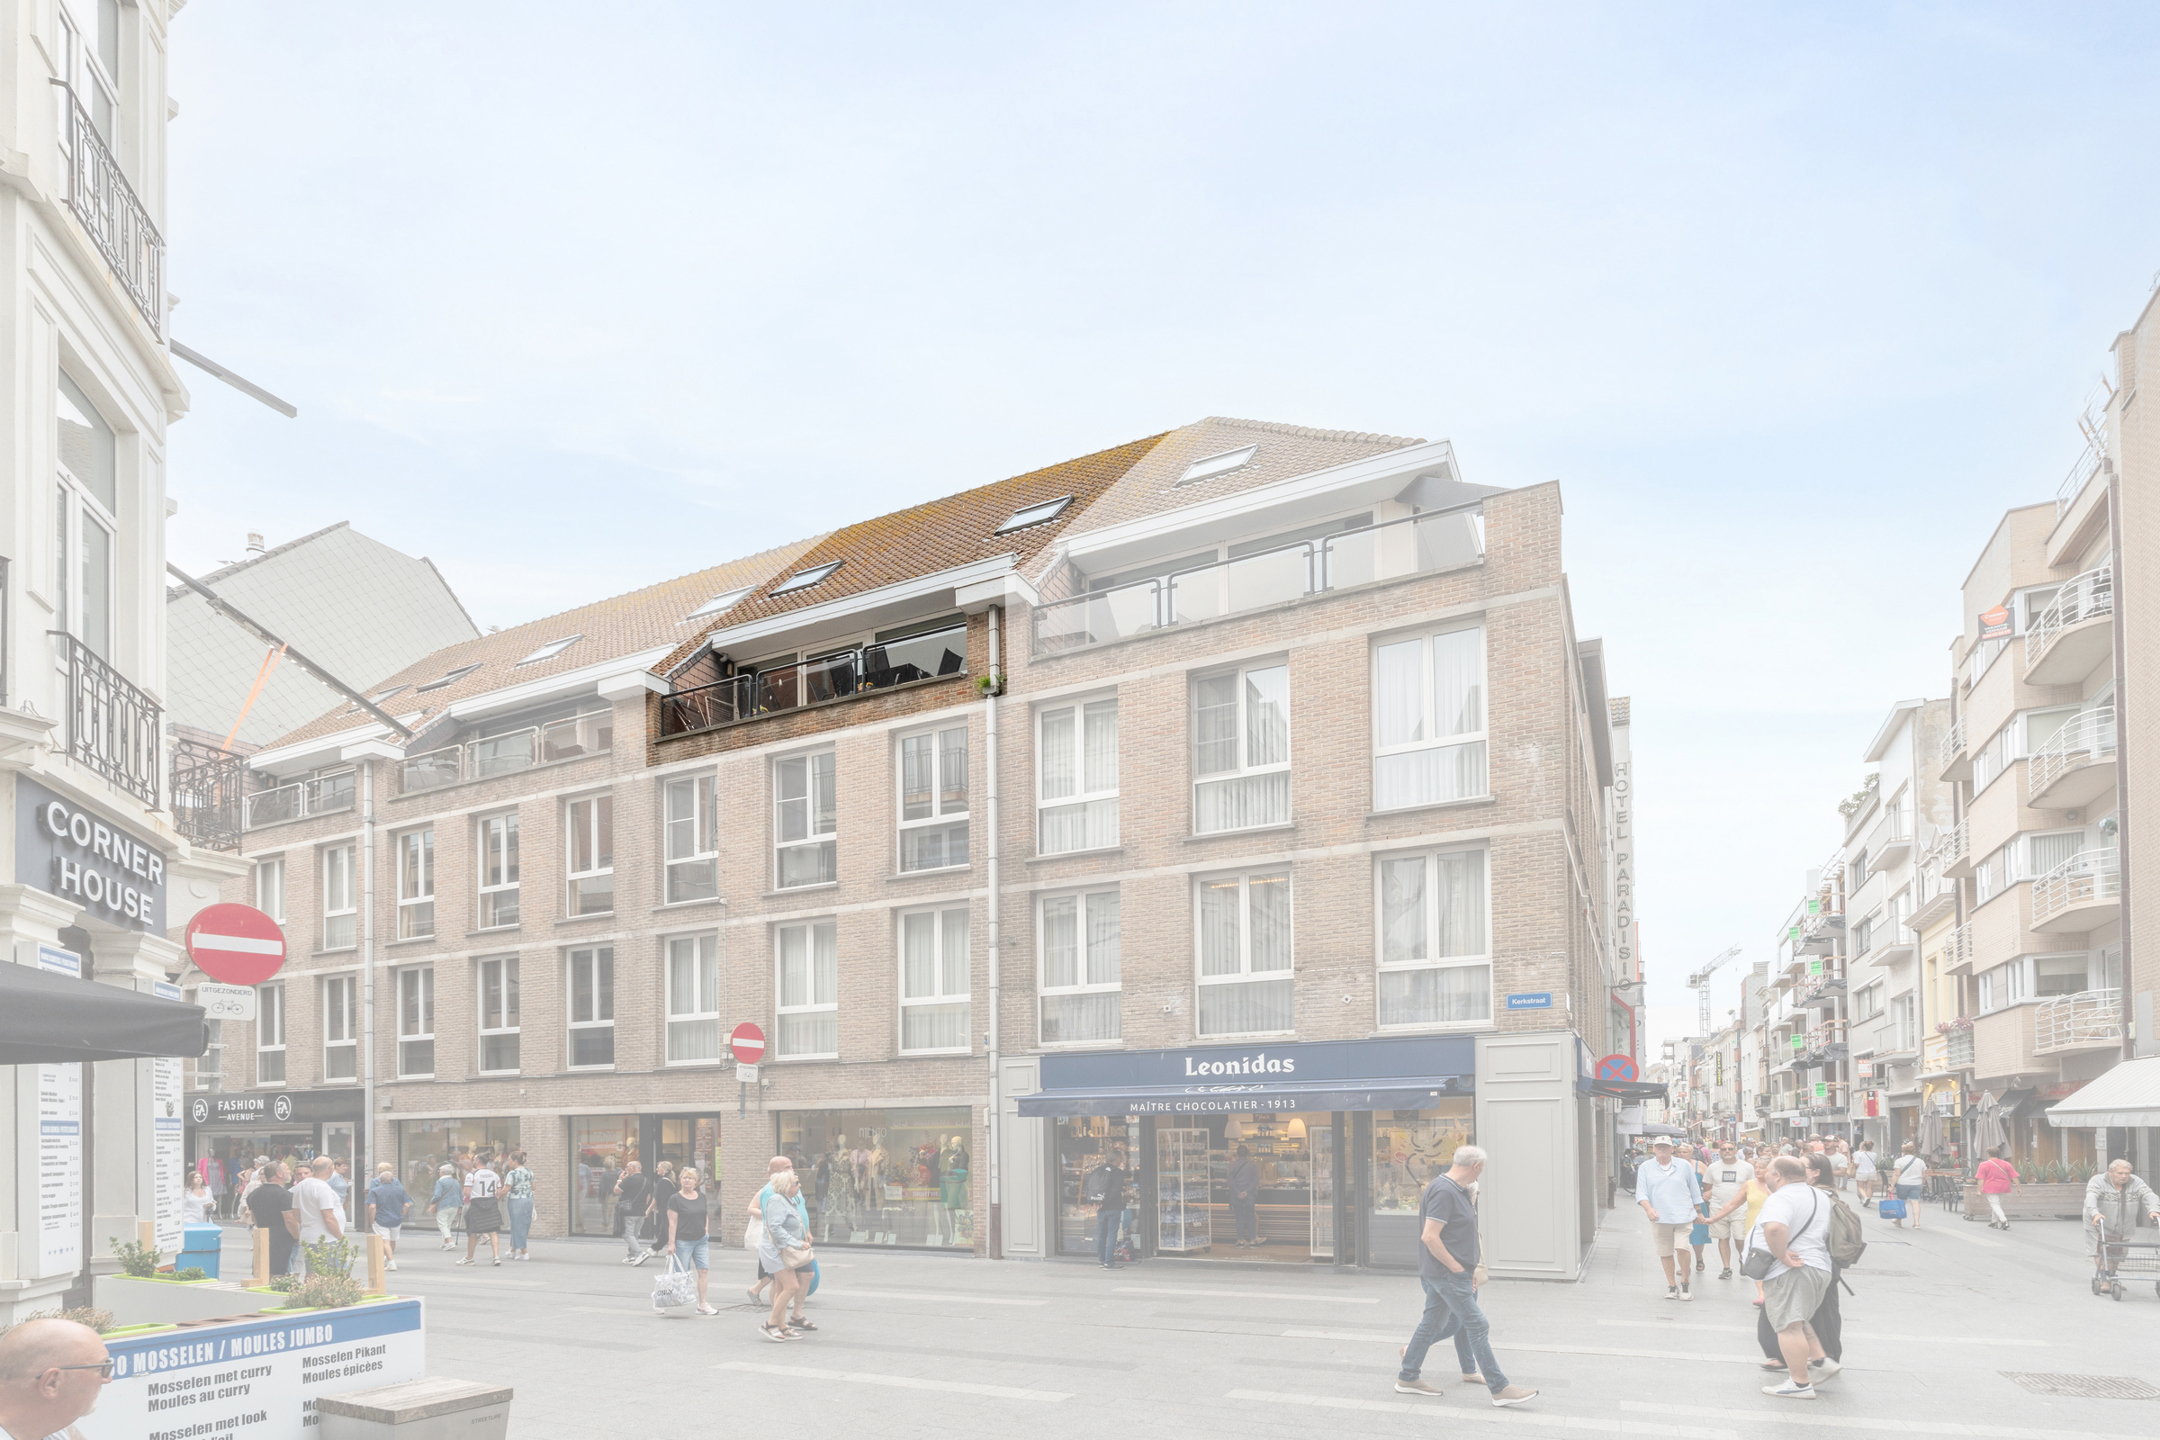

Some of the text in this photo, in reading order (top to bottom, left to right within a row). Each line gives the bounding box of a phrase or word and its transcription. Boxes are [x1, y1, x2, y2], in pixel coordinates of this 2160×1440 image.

[47, 801, 163, 886] CORNER
[1615, 763, 1632, 991] HOTEL PARADISIO
[60, 856, 154, 926] HOUSE
[201, 986, 253, 996] UITGEZONDERD
[1511, 997, 1546, 1005] Kerkstraat
[1185, 1053, 1295, 1076] Leonidas
[217, 1099, 264, 1111] FASHION
[1130, 1101, 1171, 1112] MAÎTRE
[1175, 1100, 1258, 1111] CHOCOLATIER
[1267, 1099, 1296, 1110] 1913
[226, 1113, 255, 1121] AVENUE
[479, 1180, 496, 1196] 14
[656, 1288, 674, 1296] ONLY
[133, 1342, 214, 1373] MOSSELEN
[231, 1329, 286, 1358] MOULES
[289, 1324, 333, 1348] JUMBO
[302, 1344, 386, 1368] Mosselen Pikant
[148, 1364, 273, 1396] Mosselen met curry
[302, 1360, 383, 1384] Moules épicèes
[148, 1383, 251, 1412] Moules au curry
[149, 1409, 268, 1440] Mosselen met look
[471, 1413, 502, 1424] STREETLIFE
